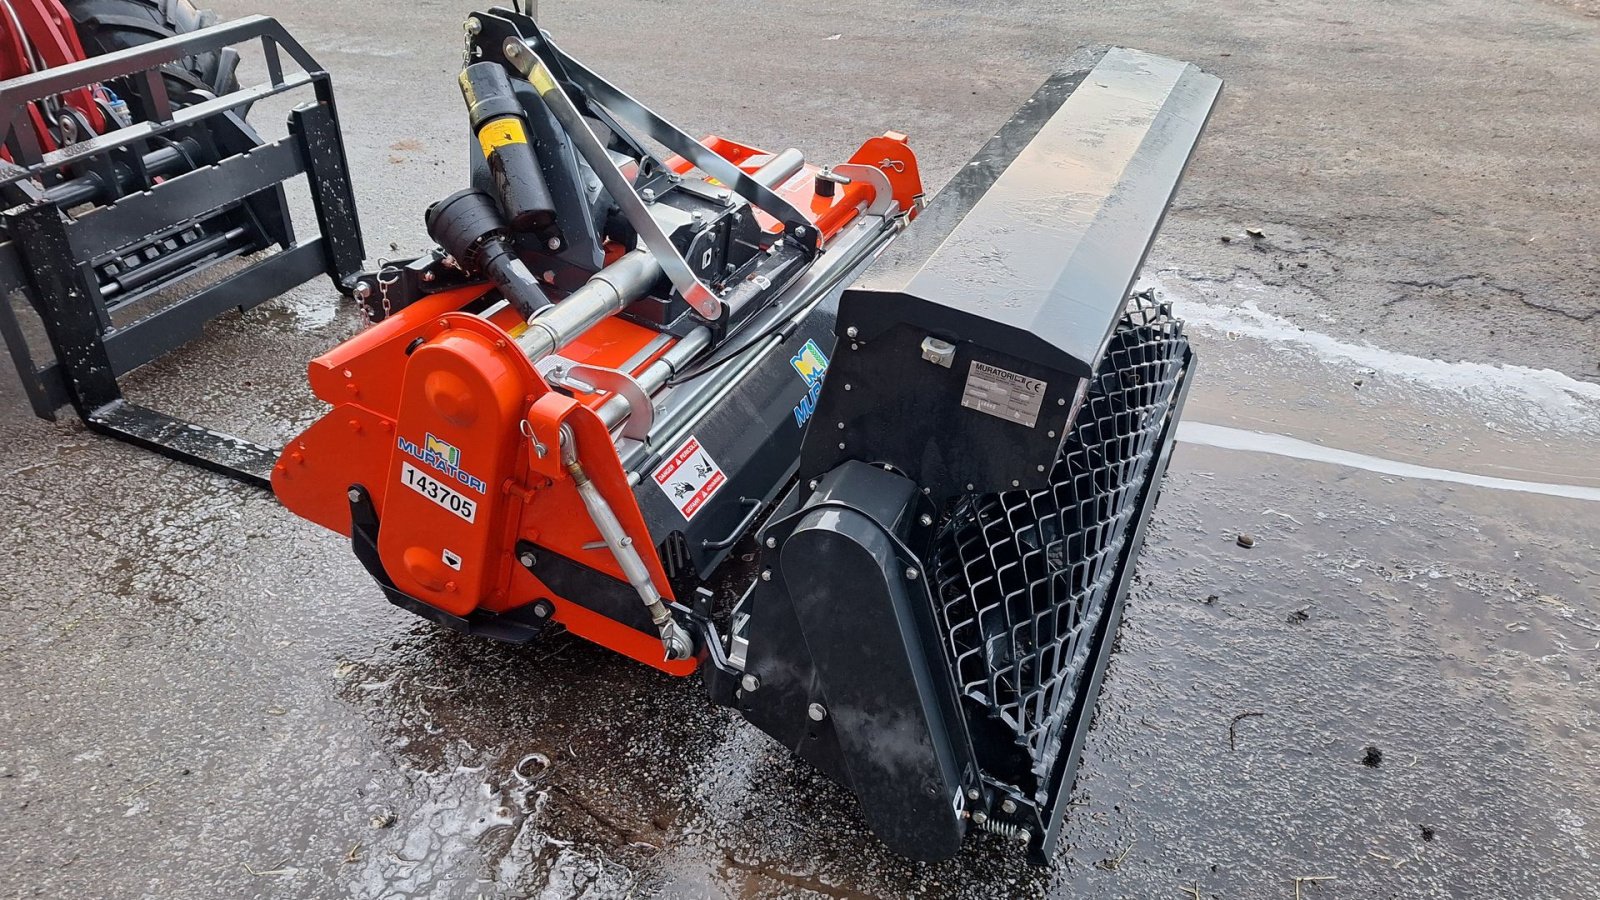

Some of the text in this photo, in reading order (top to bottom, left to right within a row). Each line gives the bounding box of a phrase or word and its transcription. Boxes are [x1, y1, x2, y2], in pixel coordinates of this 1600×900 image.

[975, 362, 1014, 380] MURATORI
[398, 436, 486, 494] MURATORI
[657, 441, 698, 482] DANGER PERICOLO
[406, 468, 473, 519] 143705
[685, 497, 701, 514] GEFAHR
